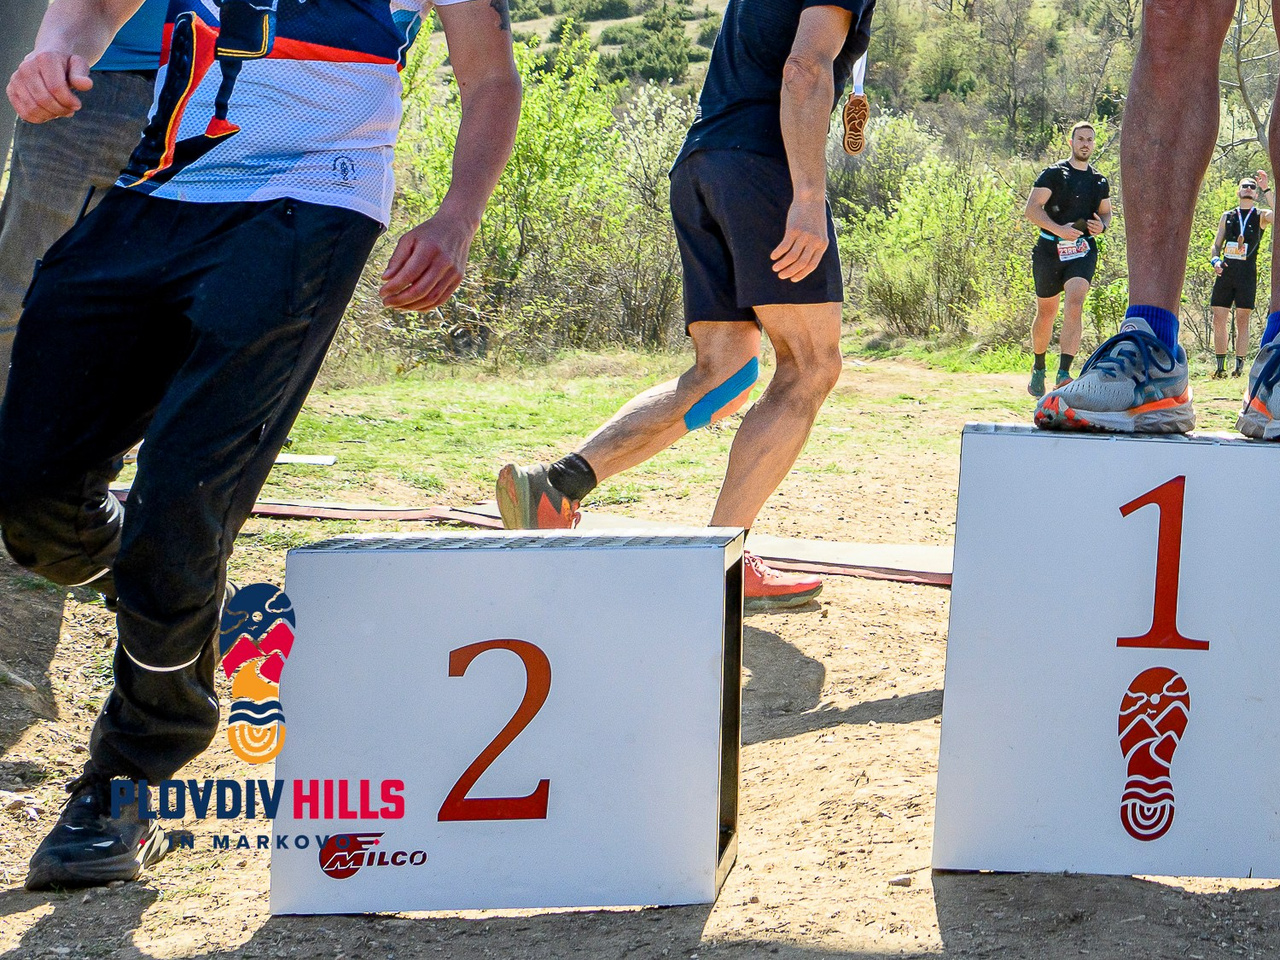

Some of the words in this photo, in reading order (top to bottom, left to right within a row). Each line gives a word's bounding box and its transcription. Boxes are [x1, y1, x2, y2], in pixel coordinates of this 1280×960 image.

[1117, 476, 1209, 650] 1
[438, 639, 552, 821] 2
[322, 849, 428, 871] MILCO
